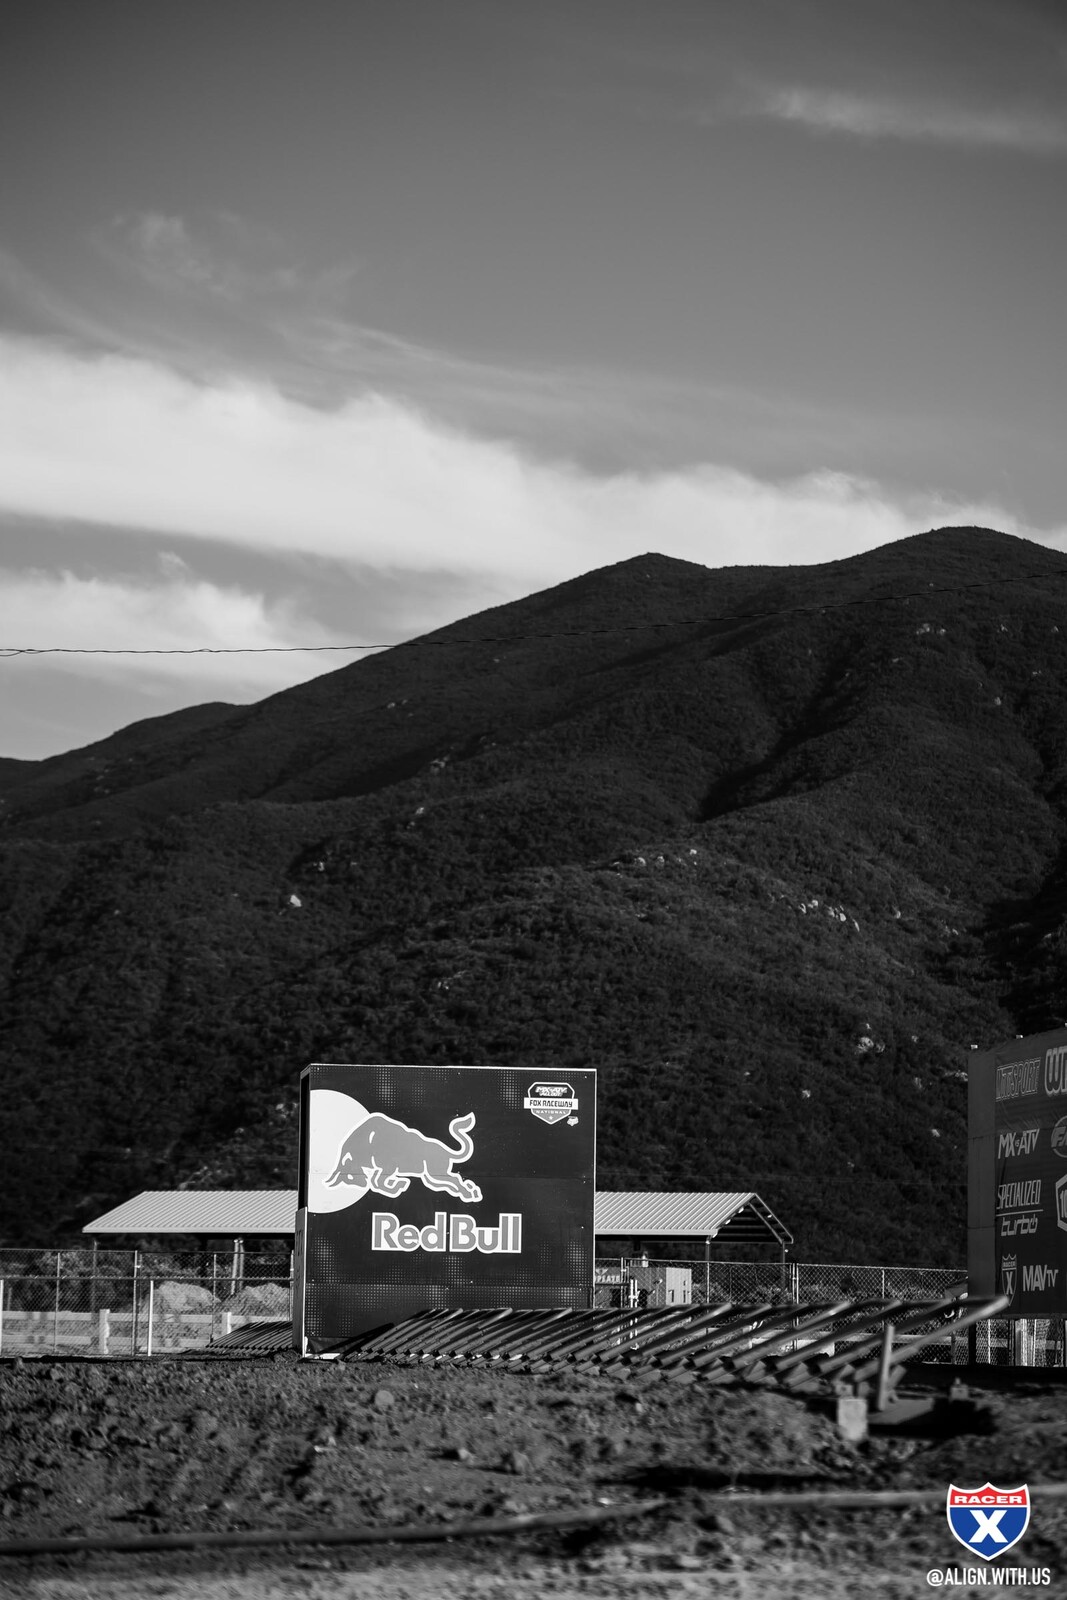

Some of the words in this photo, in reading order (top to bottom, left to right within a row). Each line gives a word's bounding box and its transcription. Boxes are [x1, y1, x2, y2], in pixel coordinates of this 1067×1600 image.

[529, 1099, 542, 1107] FOX
[543, 1100, 573, 1108] RACEWAY
[996, 1179, 1042, 1210] SPECIALIZED
[371, 1211, 447, 1253] Red
[449, 1212, 523, 1254] Bull
[1000, 1214, 1038, 1237] turbo
[1006, 1271, 1014, 1295] X
